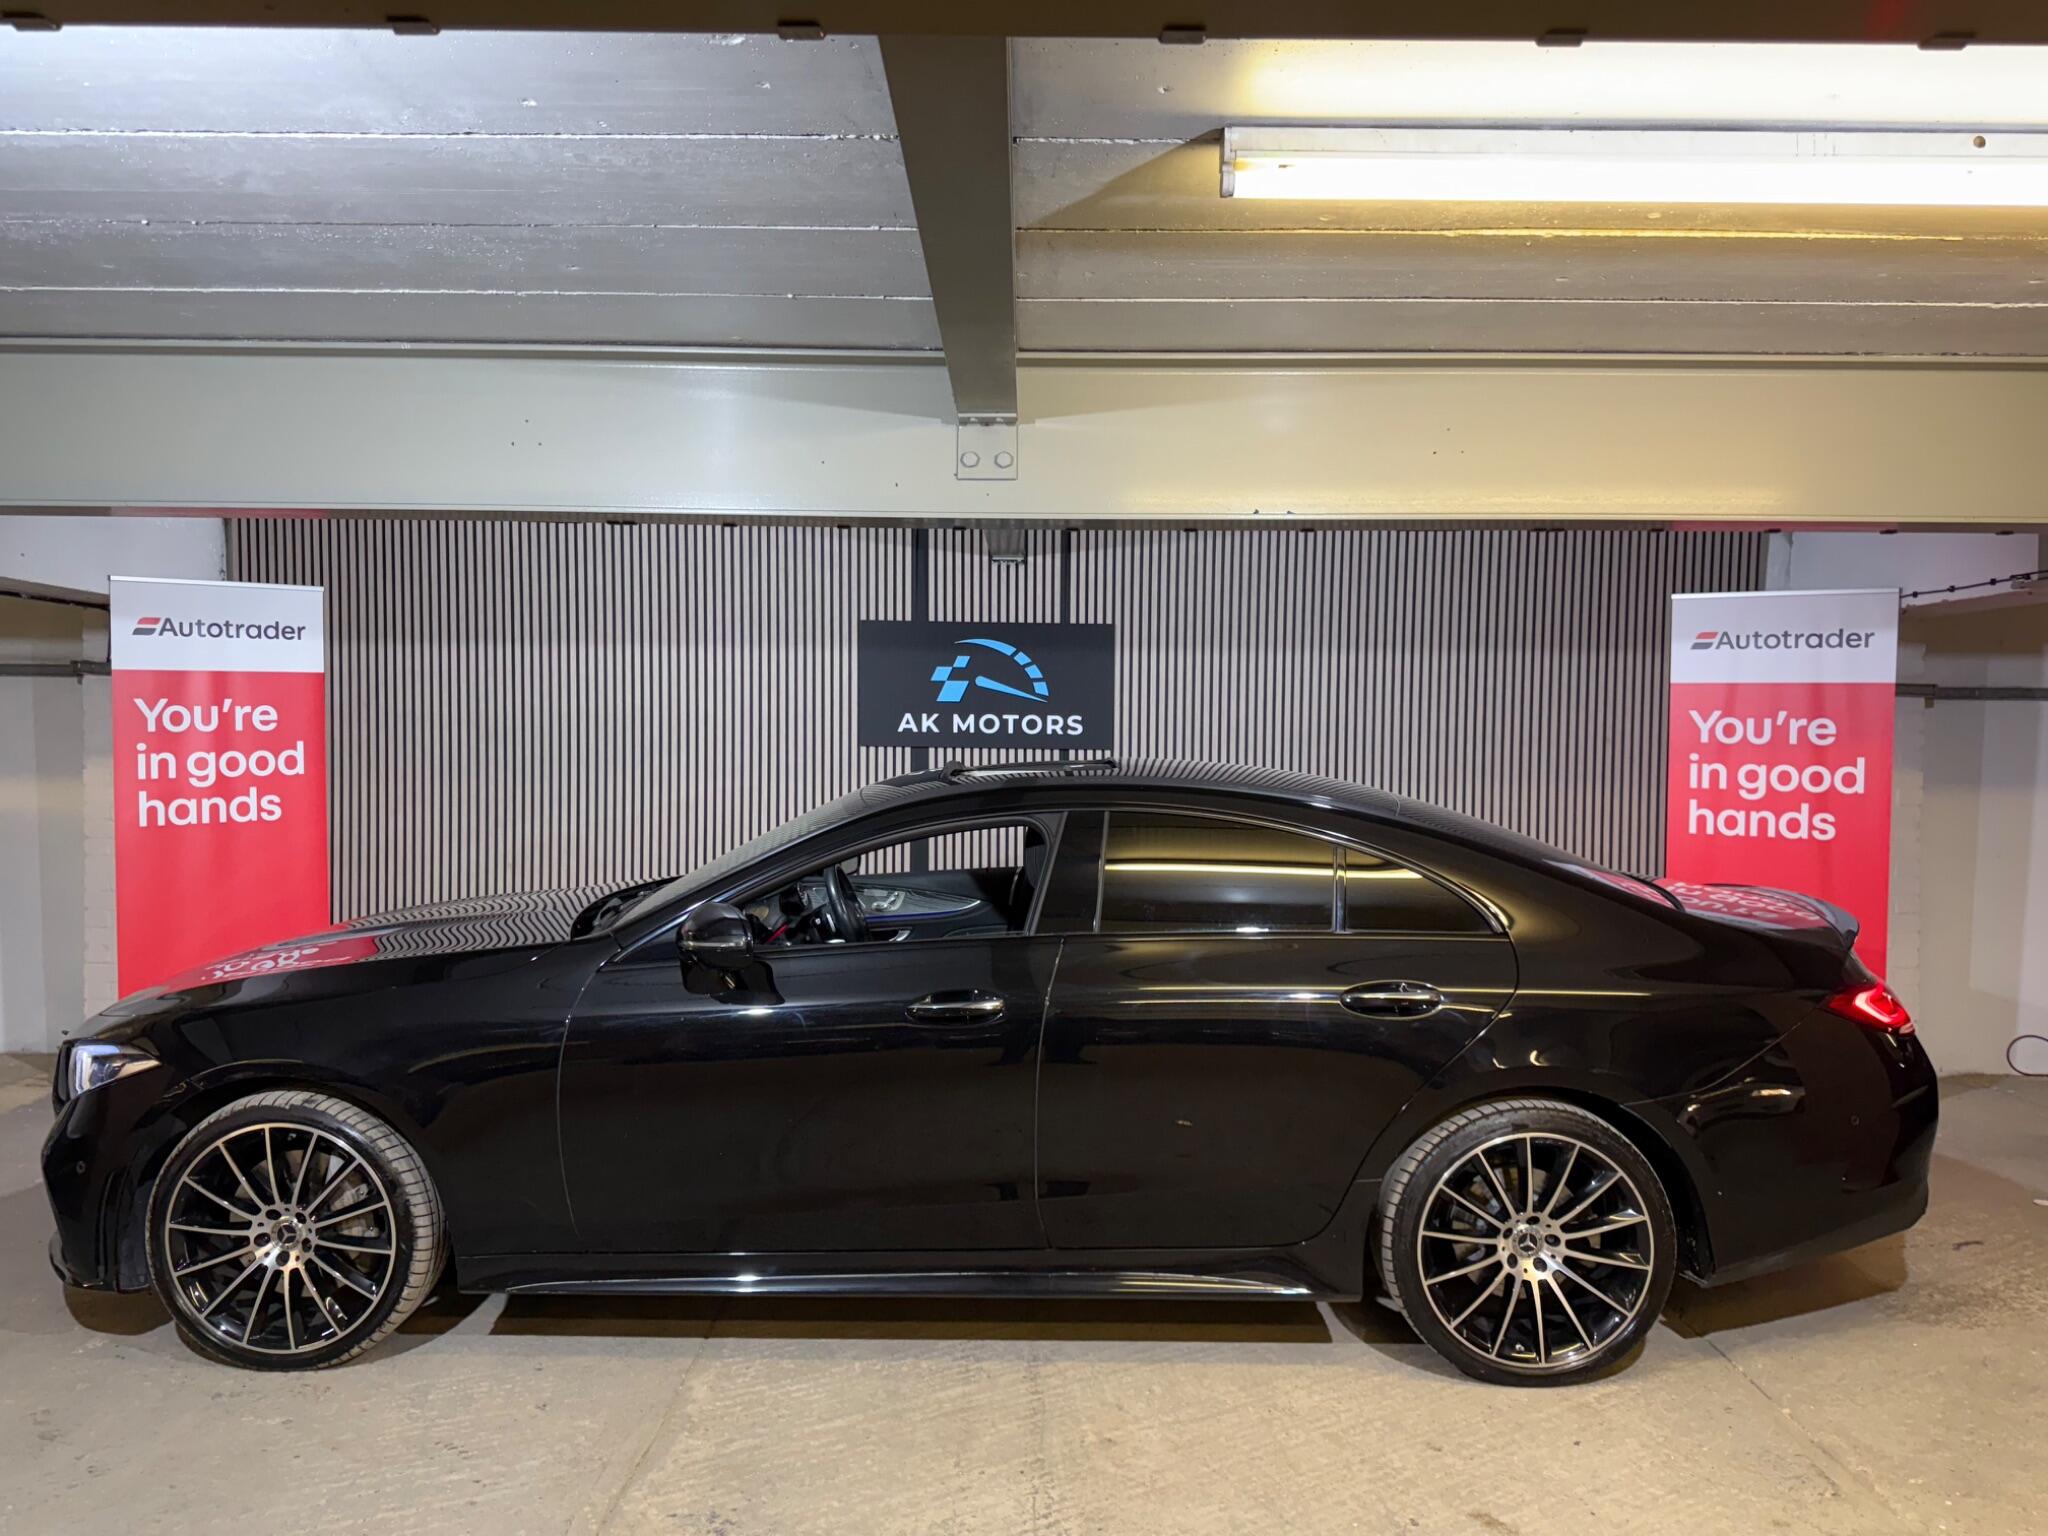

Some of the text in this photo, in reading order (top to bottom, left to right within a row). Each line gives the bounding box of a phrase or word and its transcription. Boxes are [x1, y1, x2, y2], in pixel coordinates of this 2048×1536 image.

[158, 617, 306, 641] Autotrader
[1715, 628, 1875, 650] Autotrader
[133, 697, 278, 733] You're
[897, 712, 1084, 736] AK MOTORS
[1688, 709, 1837, 746] You're
[136, 740, 305, 788] in good
[1688, 752, 1865, 800] in good
[138, 786, 282, 827] hands
[1688, 798, 1836, 840] hands
